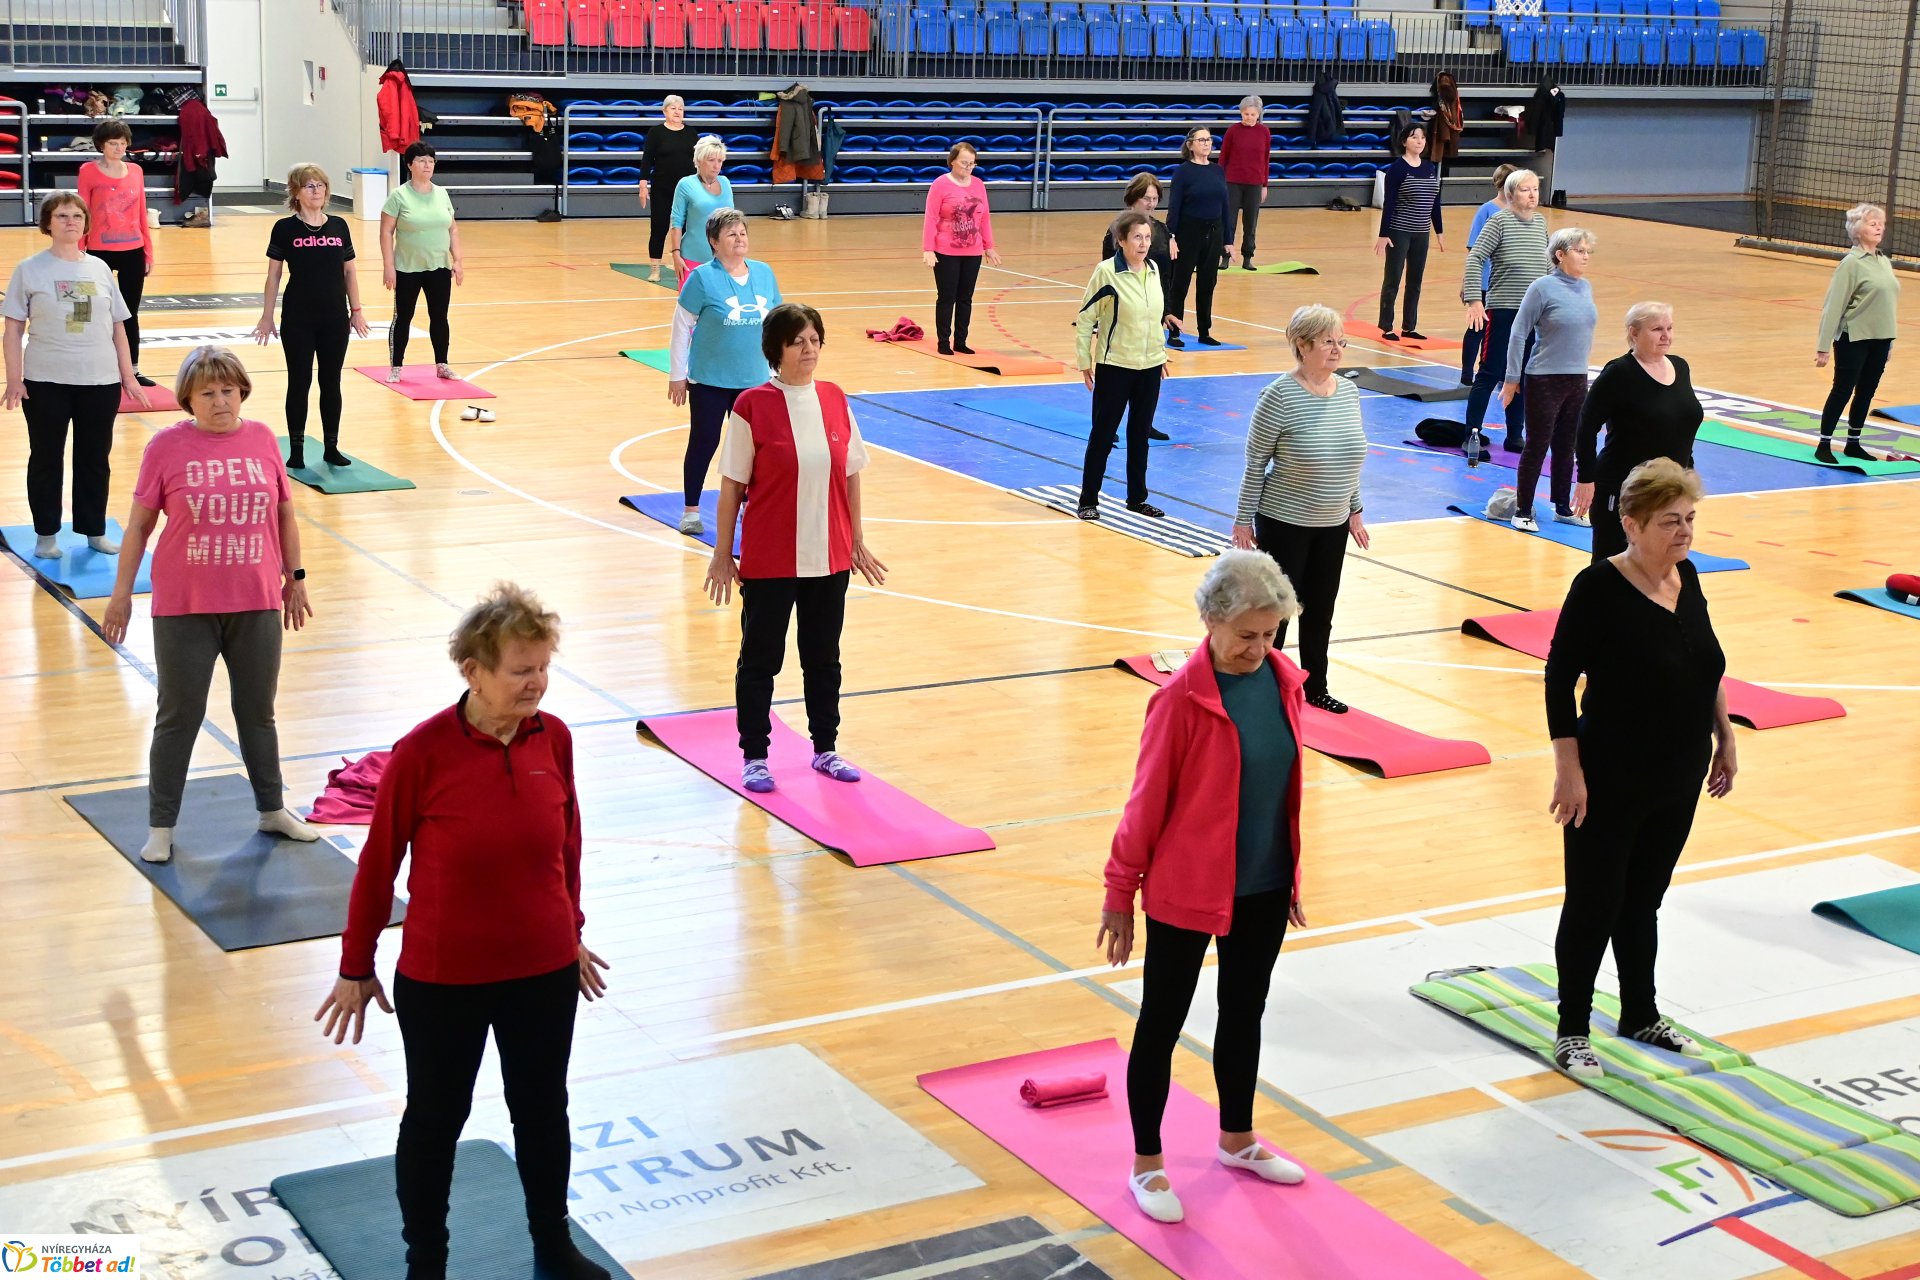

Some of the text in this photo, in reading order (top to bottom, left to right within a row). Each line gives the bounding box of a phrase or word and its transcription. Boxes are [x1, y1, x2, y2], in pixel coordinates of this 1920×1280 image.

[293, 235, 343, 248] adidas
[186, 458, 268, 487] OPEN
[186, 492, 270, 525] YOUR
[186, 533, 263, 565] MIND
[620, 1174, 788, 1215] Nonprofit
[789, 1161, 852, 1180] Kft.
